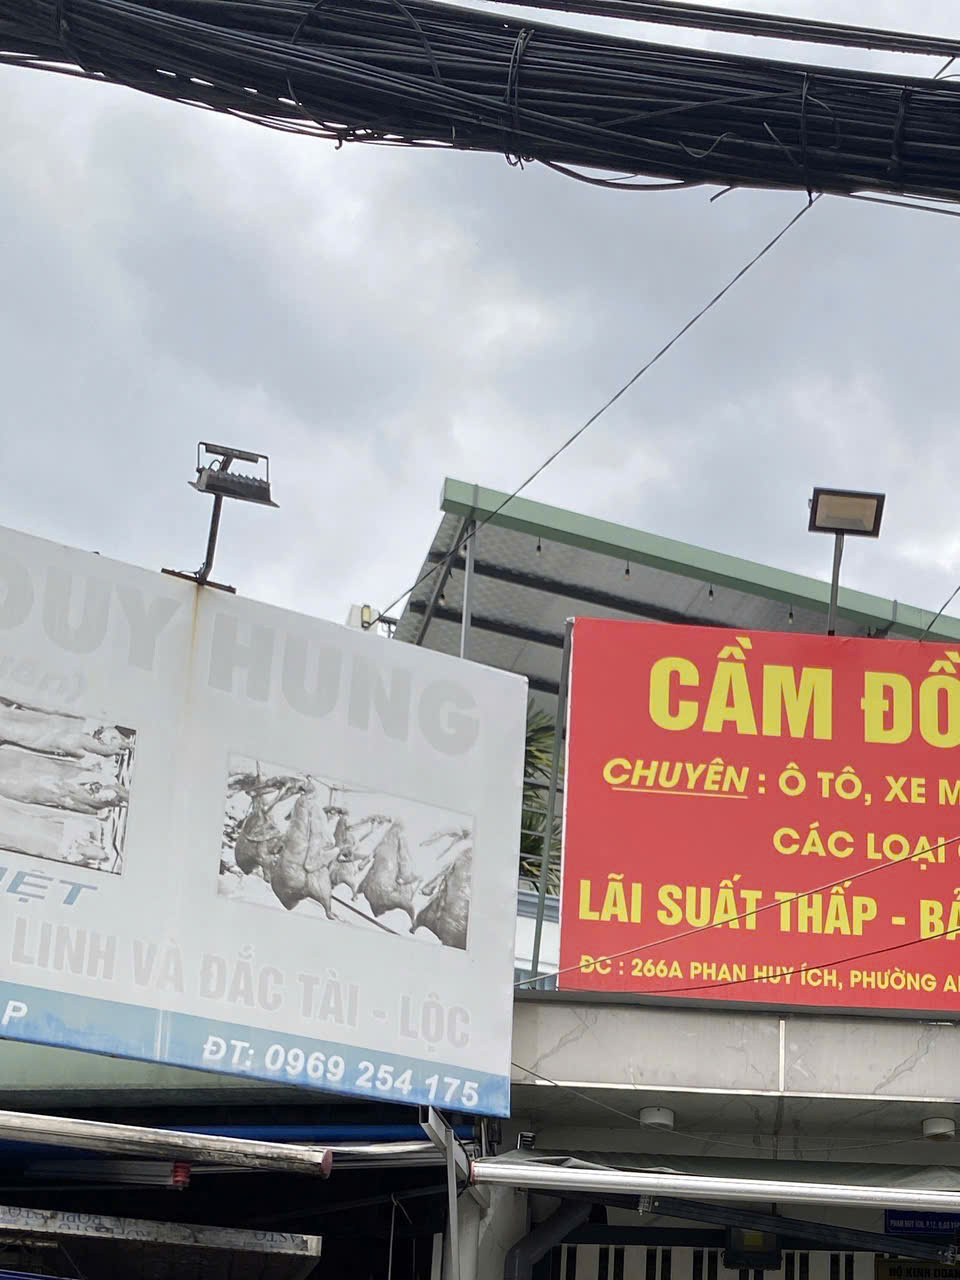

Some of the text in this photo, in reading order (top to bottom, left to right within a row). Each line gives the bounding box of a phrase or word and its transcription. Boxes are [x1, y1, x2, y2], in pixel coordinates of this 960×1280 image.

[208, 612, 480, 756] HUNG
[649, 636, 832, 740] CẦM
[602, 757, 749, 795] CHUYÊN
[778, 763, 807, 797] Ô
[817, 766, 872, 806] TÔ,
[884, 775, 925, 804] XE
[773, 822, 854, 858] CÁC
[866, 832, 945, 870] LOẠI
[578, 873, 642, 924] LÃI
[657, 874, 762, 931] SUẤT
[774, 880, 877, 936] THẤP
[9, 917, 117, 980] LINH
[133, 936, 185, 994] VÀ
[298, 969, 360, 1027] TÀI
[399, 991, 471, 1054] LỘC
[631, 958, 683, 979] 266A
[690, 962, 747, 982] PHAN
[753, 966, 794, 985] HUY
[801, 963, 843, 990] ÍCH,
[850, 967, 937, 993] PHƯỜNG
[202, 1035, 480, 1107] ĐT: 0969 254 175
